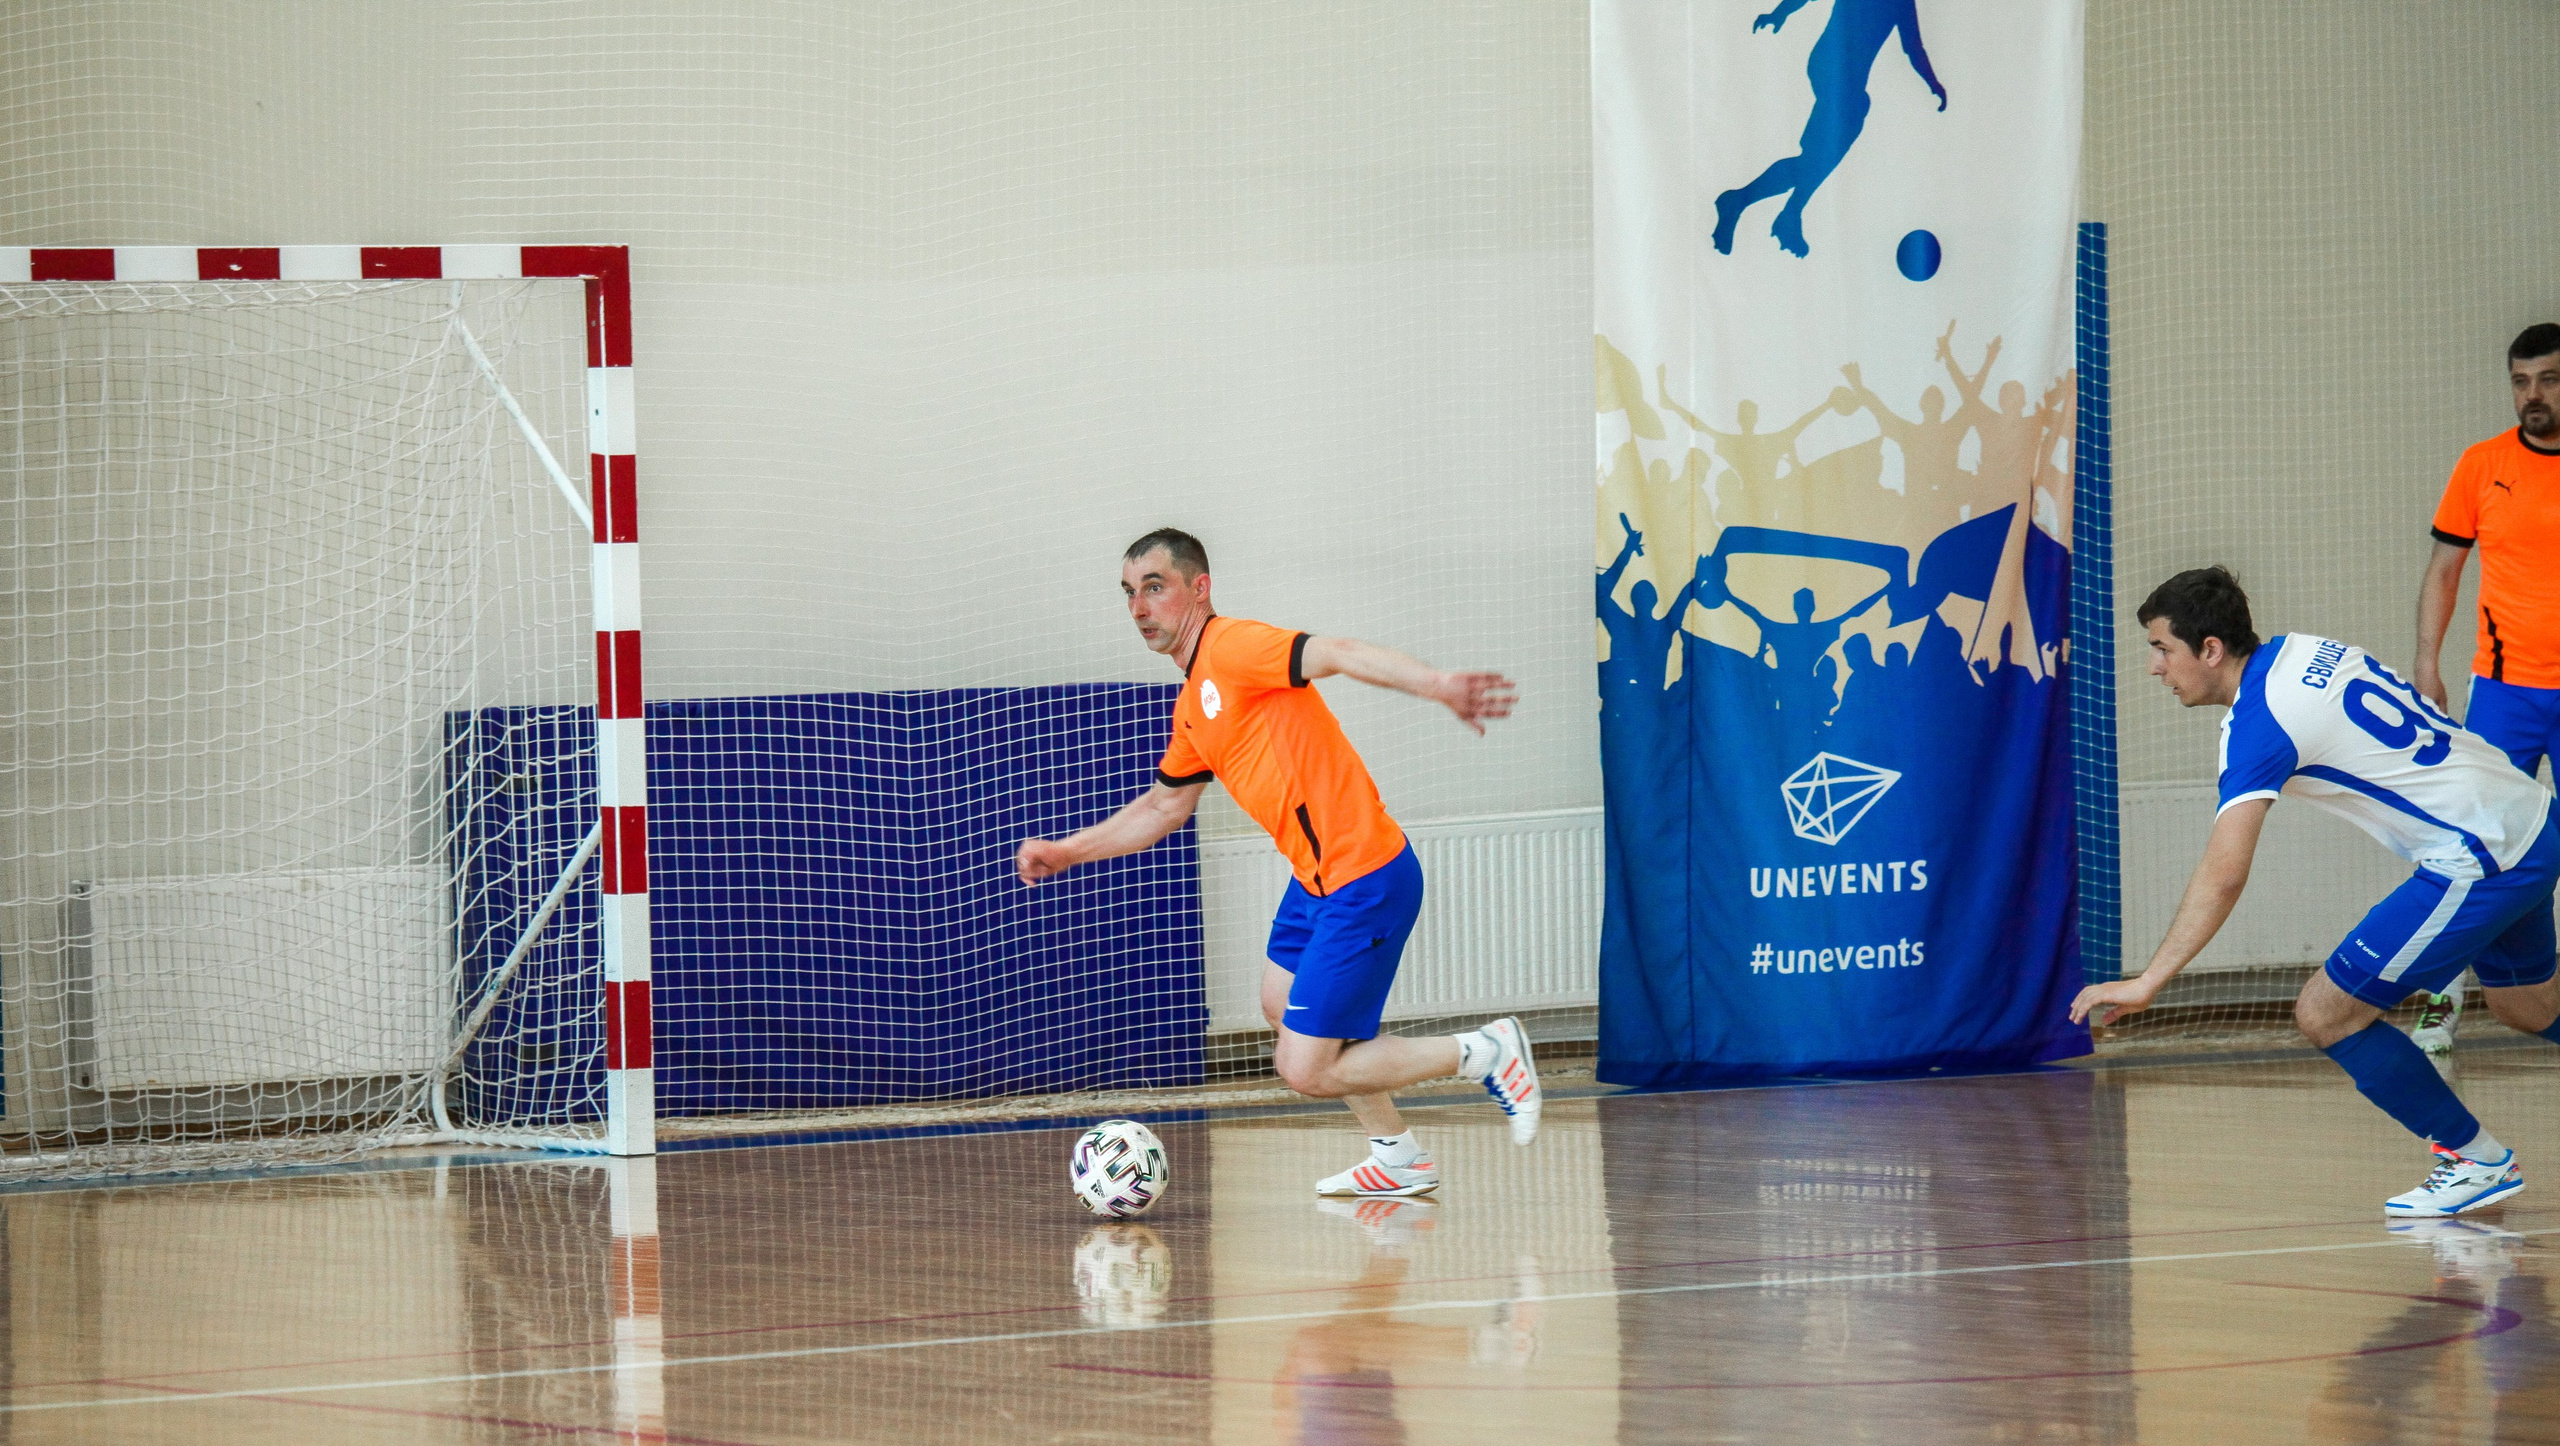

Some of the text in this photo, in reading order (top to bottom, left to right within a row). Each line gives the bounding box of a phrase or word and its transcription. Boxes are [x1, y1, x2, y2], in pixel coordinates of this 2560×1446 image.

[2343, 654, 2463, 767] 9
[1750, 859, 1928, 898] UNEVENTS
[1750, 938, 1925, 975] #unevents
